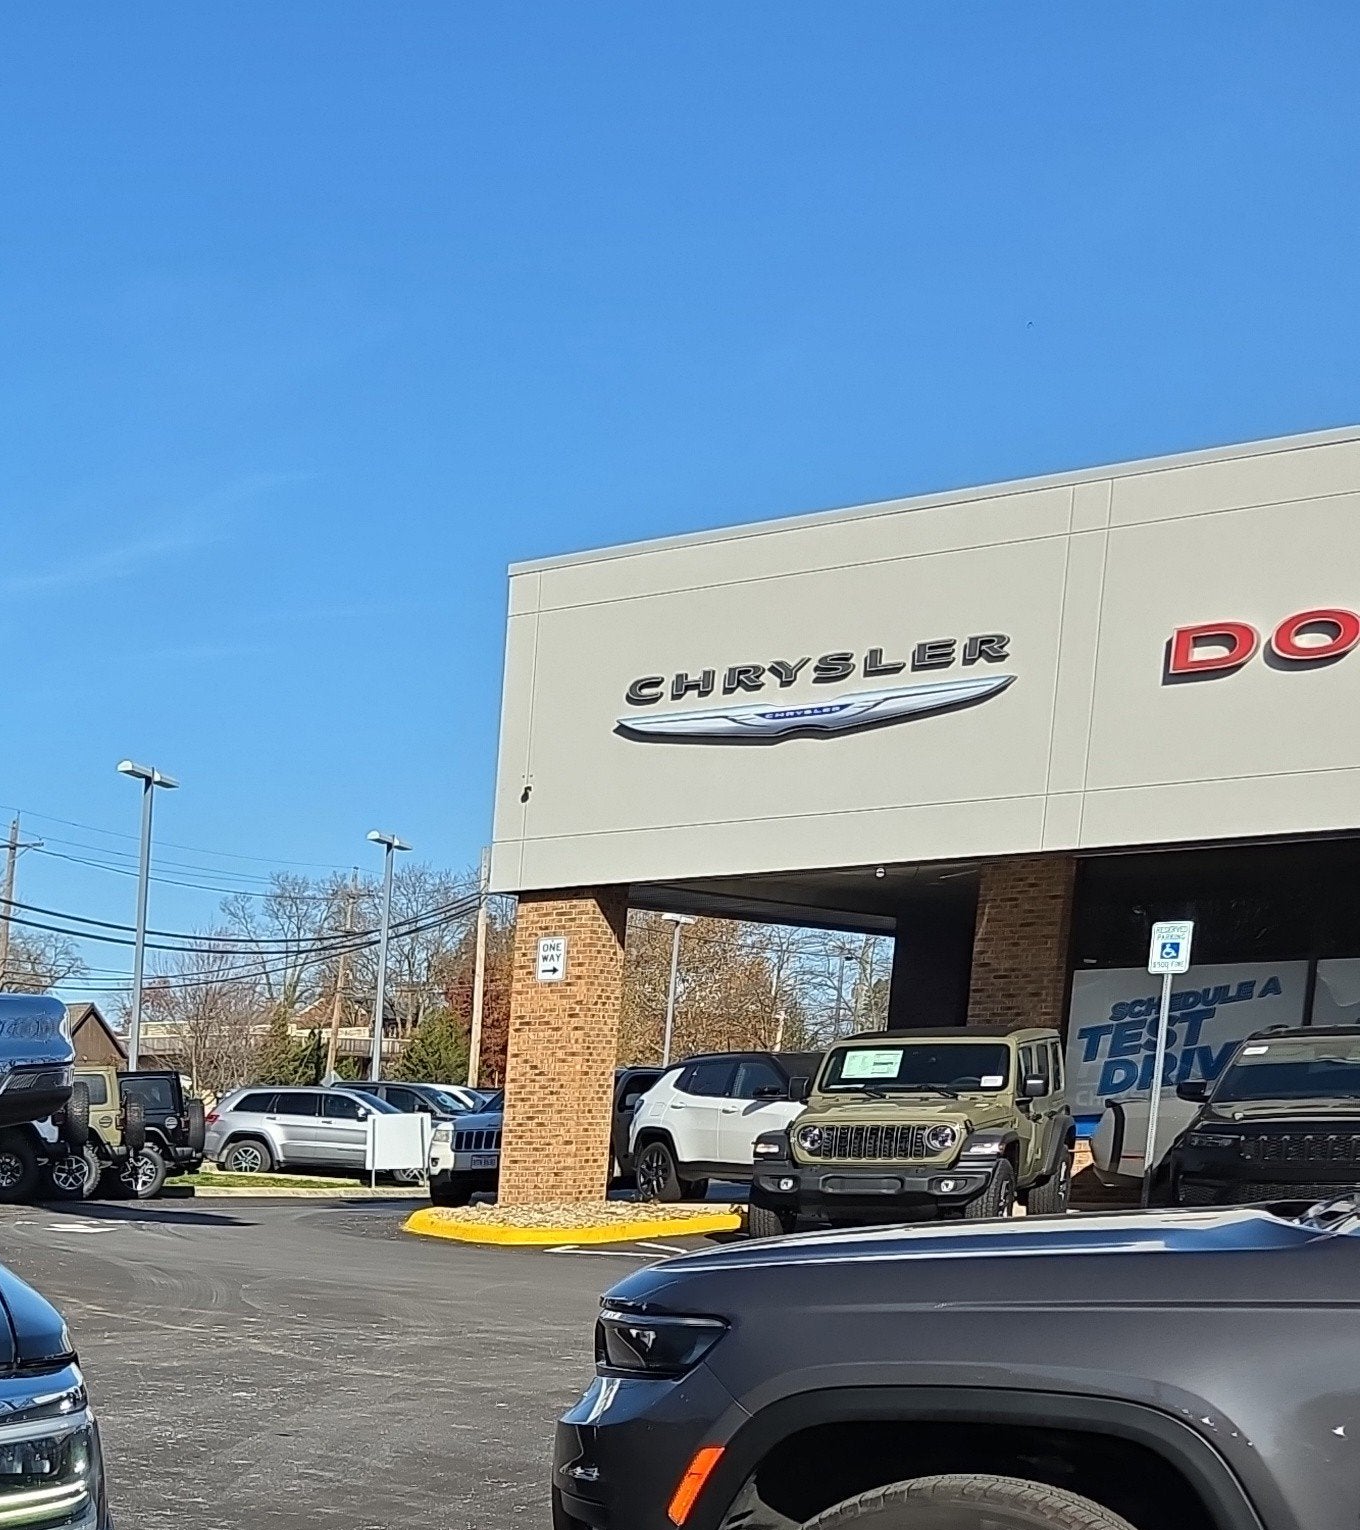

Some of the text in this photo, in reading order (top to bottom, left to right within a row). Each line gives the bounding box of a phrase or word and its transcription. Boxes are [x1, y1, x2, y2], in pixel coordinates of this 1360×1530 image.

[1168, 608, 1360, 674] DO
[625, 633, 1011, 706] CHRYSLER
[765, 706, 841, 719] CHRYSLER
[541, 953, 562, 963] WAY
[542, 942, 562, 952] ONE
[1109, 975, 1282, 1021] SCHEDULE A
[1077, 1007, 1216, 1062] TEST
